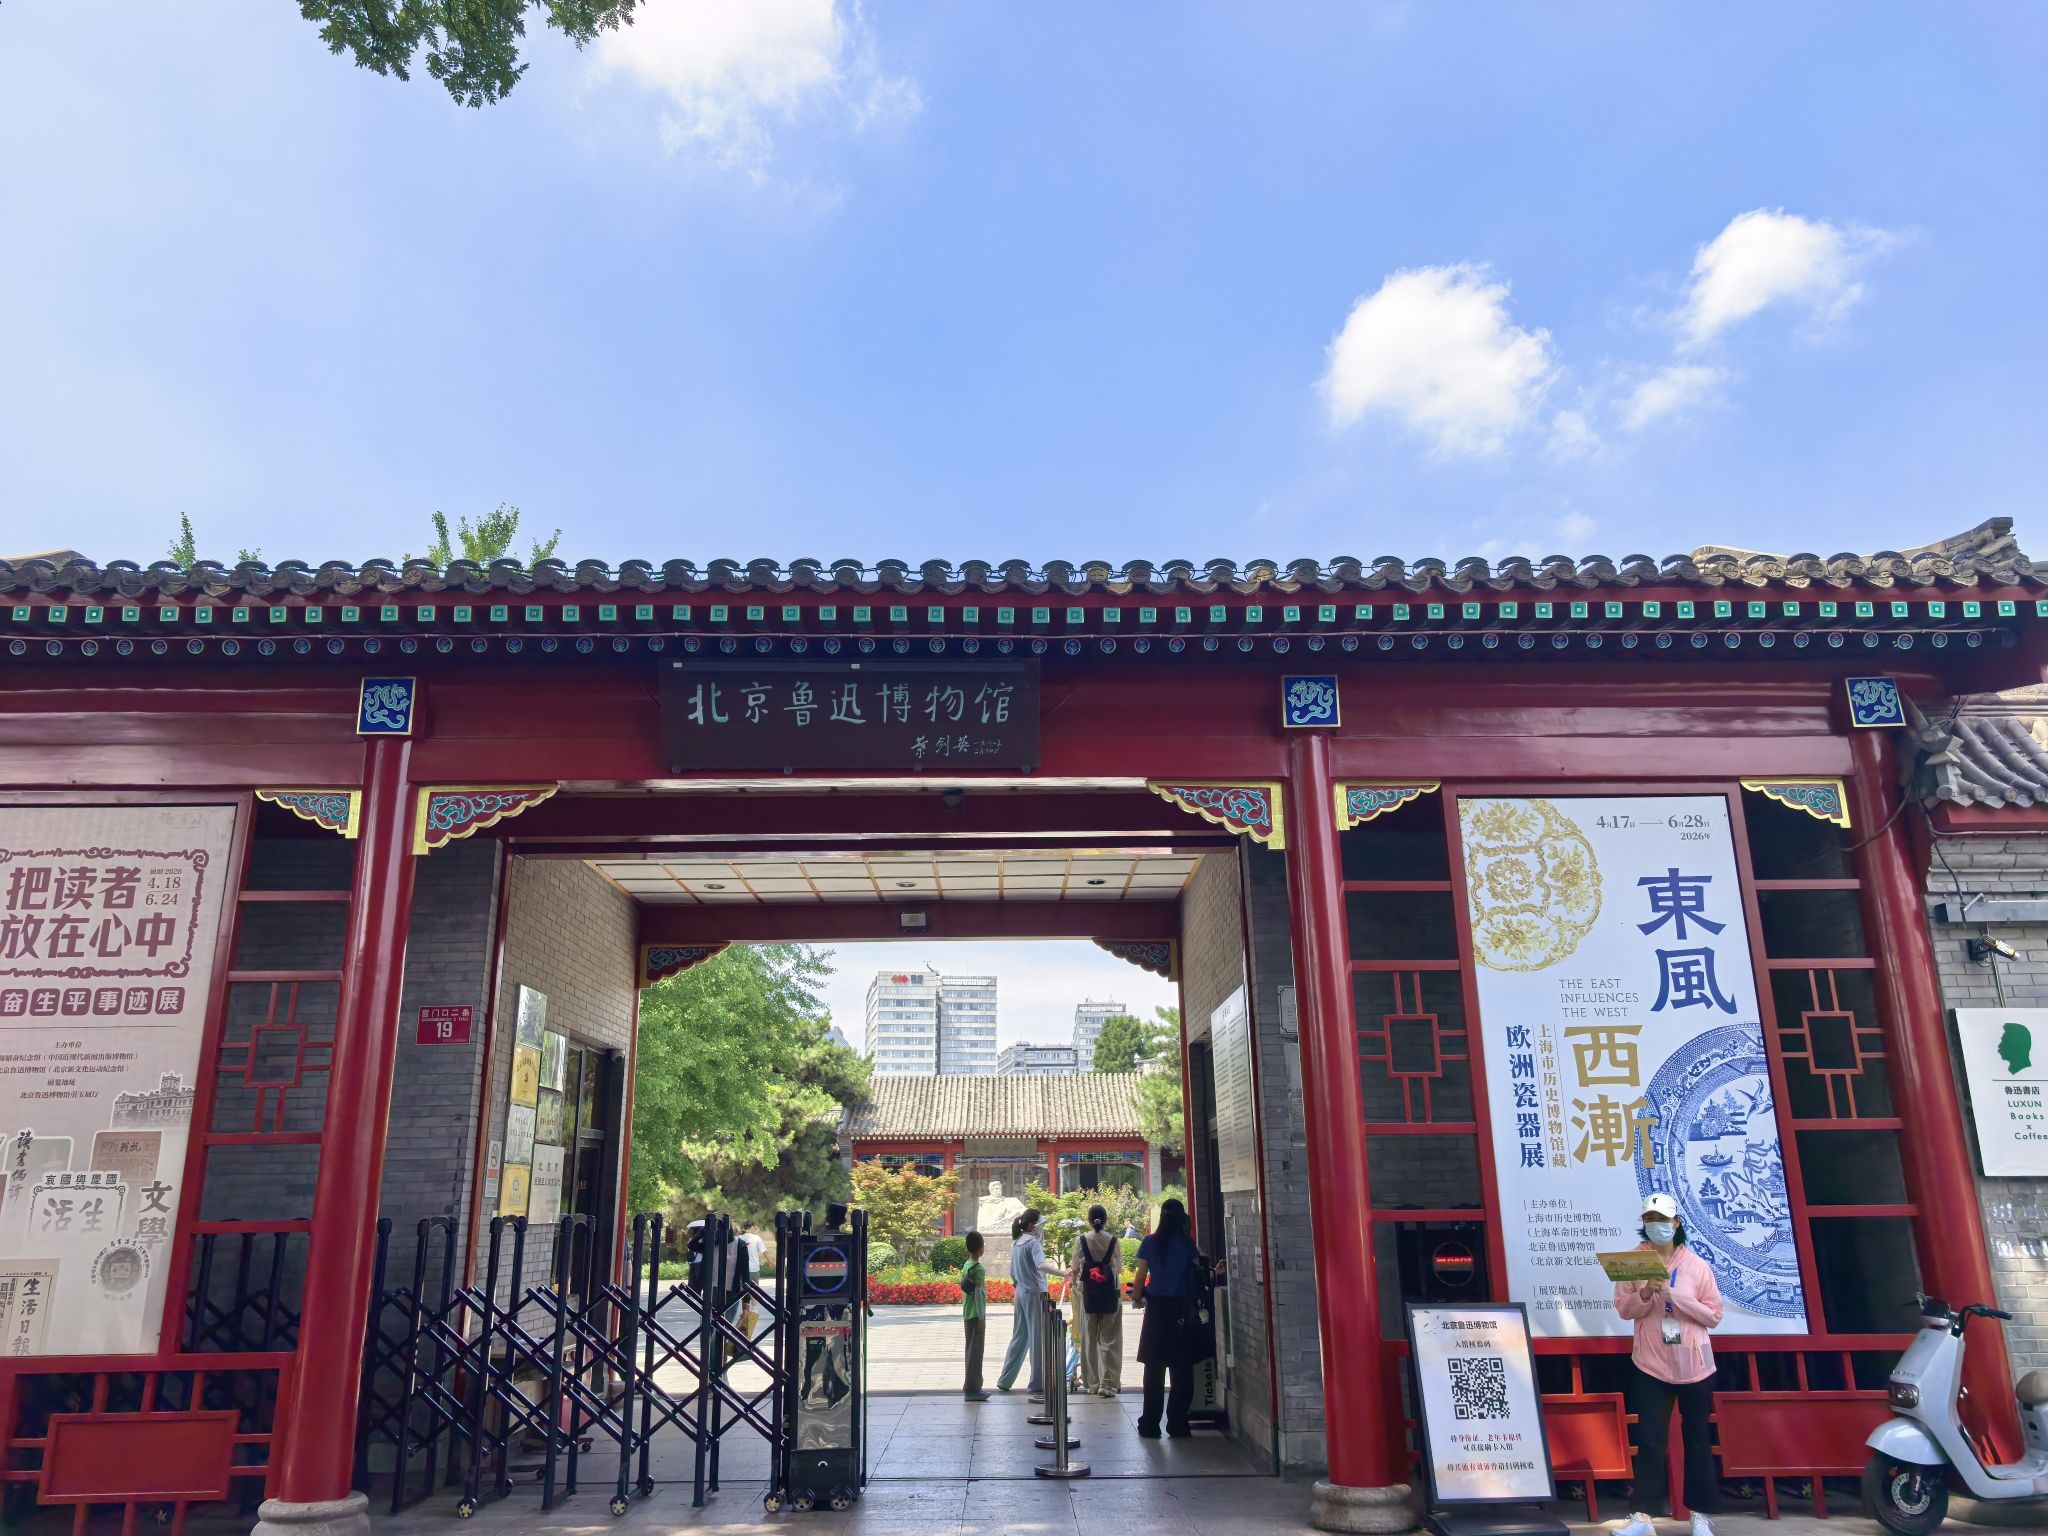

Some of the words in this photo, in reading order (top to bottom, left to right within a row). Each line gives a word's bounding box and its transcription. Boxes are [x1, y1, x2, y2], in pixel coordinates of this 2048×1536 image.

[688, 681, 1014, 727] 北京鲁迅博物馆
[1680, 832, 1711, 841] 2026年
[6, 866, 141, 911] 把读者
[147, 876, 181, 889] 4.18
[145, 893, 178, 906] 6.24
[0, 912, 176, 960] 放在心中
[1636, 868, 1738, 1015] 東風
[1558, 978, 1584, 989] THE
[1591, 978, 1621, 989] EAST
[3, 988, 180, 1014] 奋生平事迹展
[1560, 993, 1639, 1003] INFLUENCES
[1562, 1007, 1588, 1018] THE
[1594, 1007, 1629, 1018] WEST
[437, 1021, 453, 1038] 19
[1506, 1024, 1545, 1169] 欧洲瓷器展
[1538, 1023, 1568, 1168] 上海市历史博物馆藏
[1563, 1024, 1658, 1169] 西漸
[2008, 1100, 2042, 1108] LUXUN
[1530, 1199, 1568, 1209] 主办单位
[1526, 1213, 1602, 1223] 上海市历史博物馆
[1528, 1242, 1596, 1252] 北京鲁迅博物馆
[1539, 1285, 1578, 1296] 展览地点
[1442, 1321, 1498, 1330] 北京鲁迅博物馆
